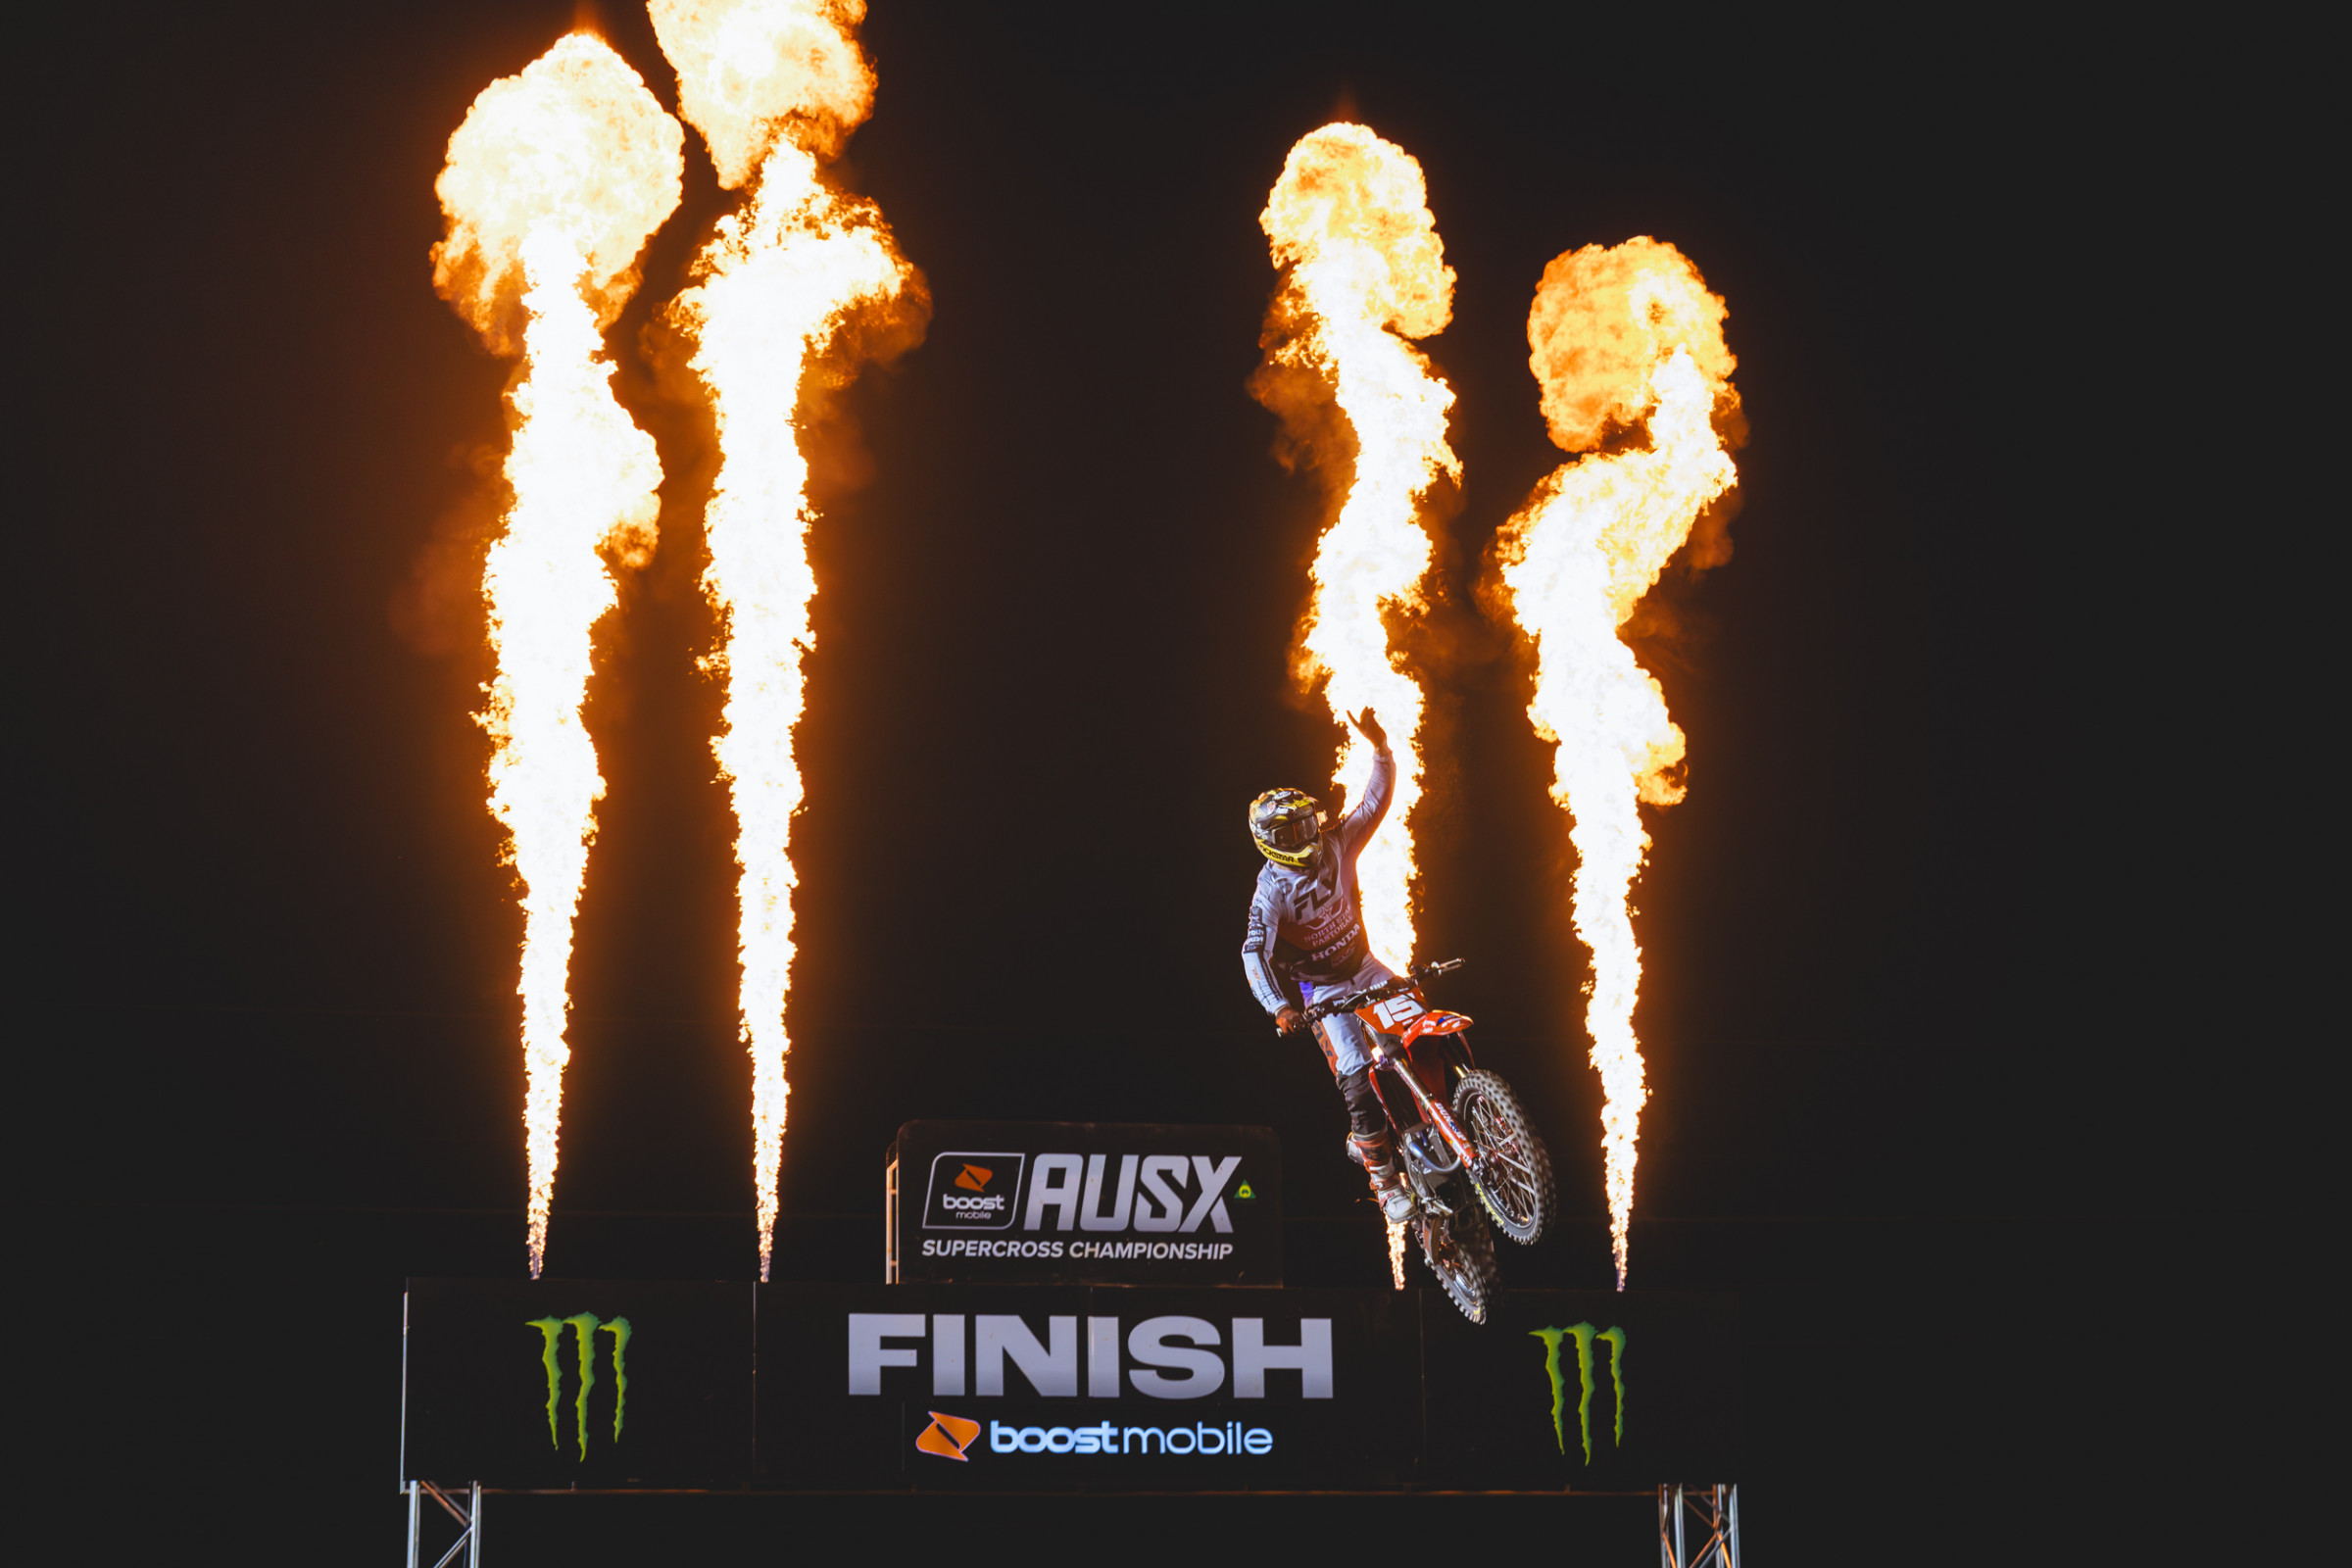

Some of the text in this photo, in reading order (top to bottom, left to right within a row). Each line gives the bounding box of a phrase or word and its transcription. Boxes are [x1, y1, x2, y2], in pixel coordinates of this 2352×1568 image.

[1258, 845, 1294, 862] OCKSTAR
[1294, 868, 1338, 920] FLY
[1311, 923, 1360, 960] HONDA
[1373, 992, 1423, 1030] 15
[943, 1193, 1004, 1211] boost
[1023, 1153, 1243, 1233] AUSX
[956, 1210, 992, 1220] mobile
[922, 1240, 1234, 1260] SUPERCROSS CHAMPIONSHIP
[849, 1313, 1333, 1399] FINISH
